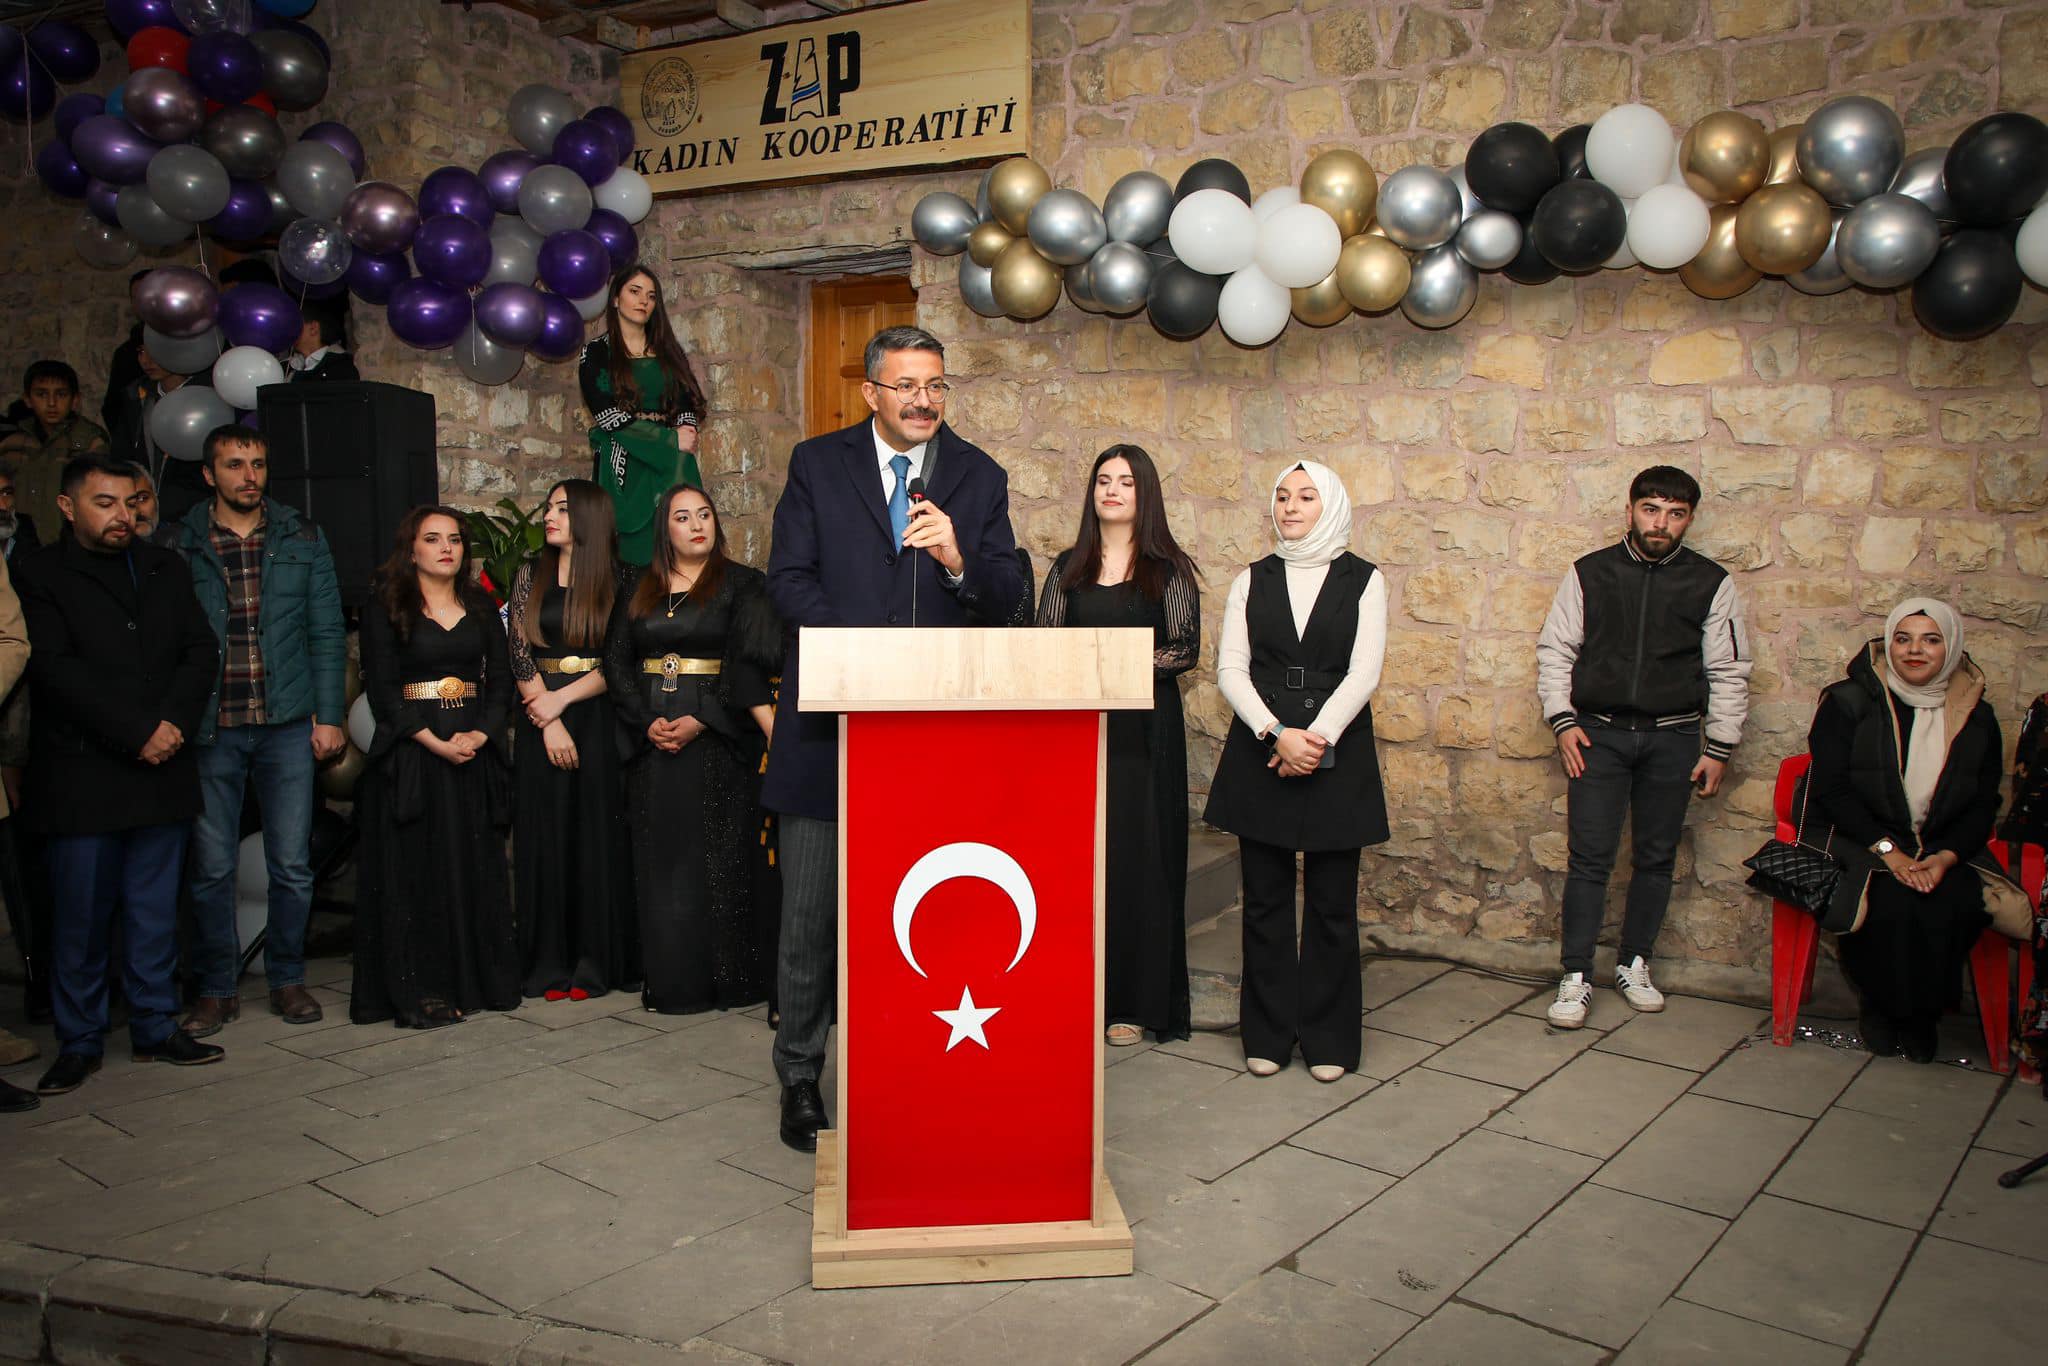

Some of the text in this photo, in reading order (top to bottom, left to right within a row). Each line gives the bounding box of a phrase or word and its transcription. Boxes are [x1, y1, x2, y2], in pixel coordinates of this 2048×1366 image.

[760, 31, 860, 125] ZAP
[633, 97, 1017, 175] KADIN KOOPERATİFİ
